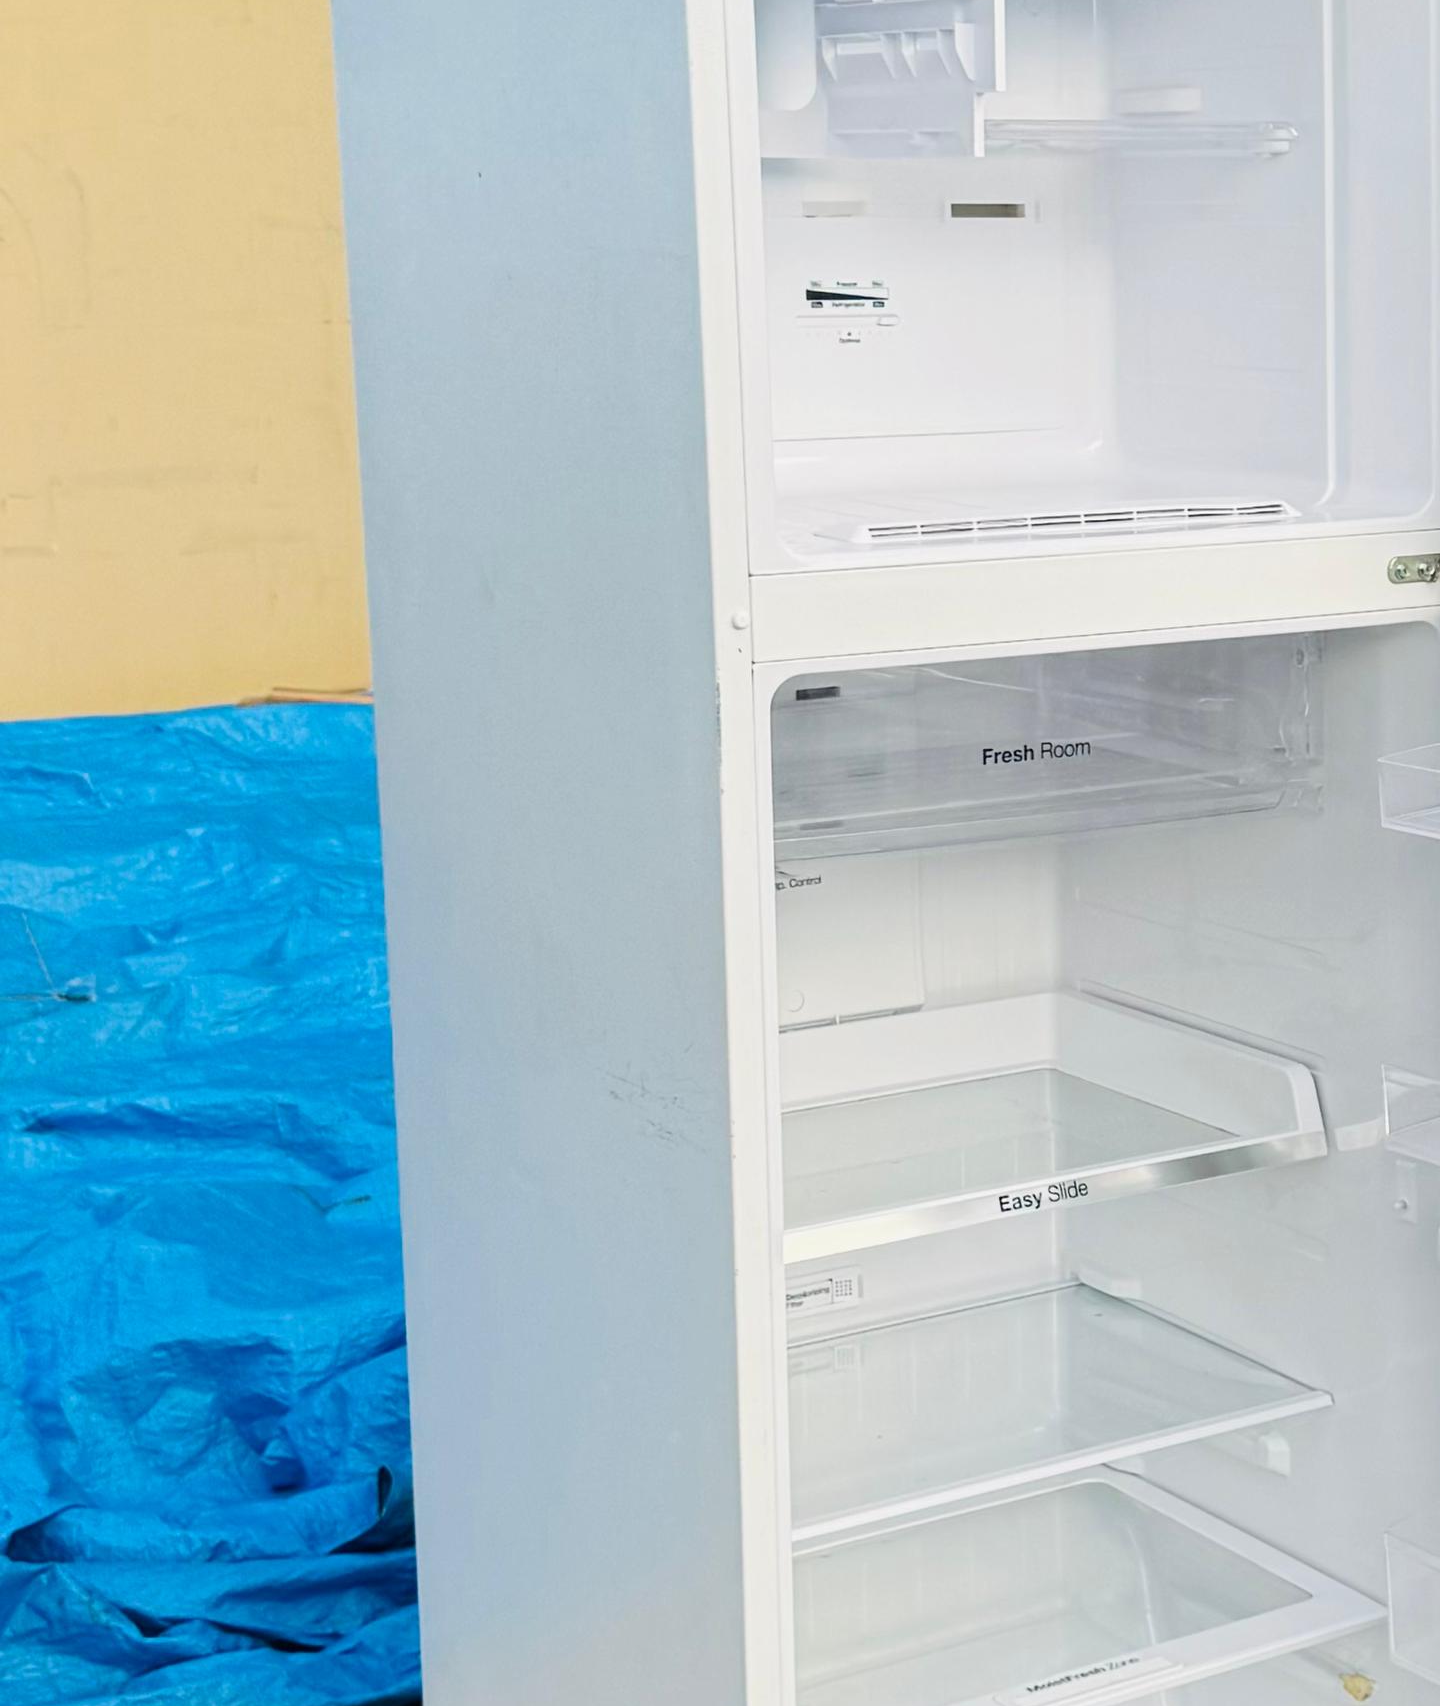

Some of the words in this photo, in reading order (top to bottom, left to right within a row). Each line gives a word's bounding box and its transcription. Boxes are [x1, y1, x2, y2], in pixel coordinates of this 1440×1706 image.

[982, 744, 1035, 766] Fresh
[1040, 741, 1091, 760] Room
[789, 875, 822, 888] Control
[998, 1192, 1043, 1213] Easy
[1047, 1180, 1089, 1203] Slide
